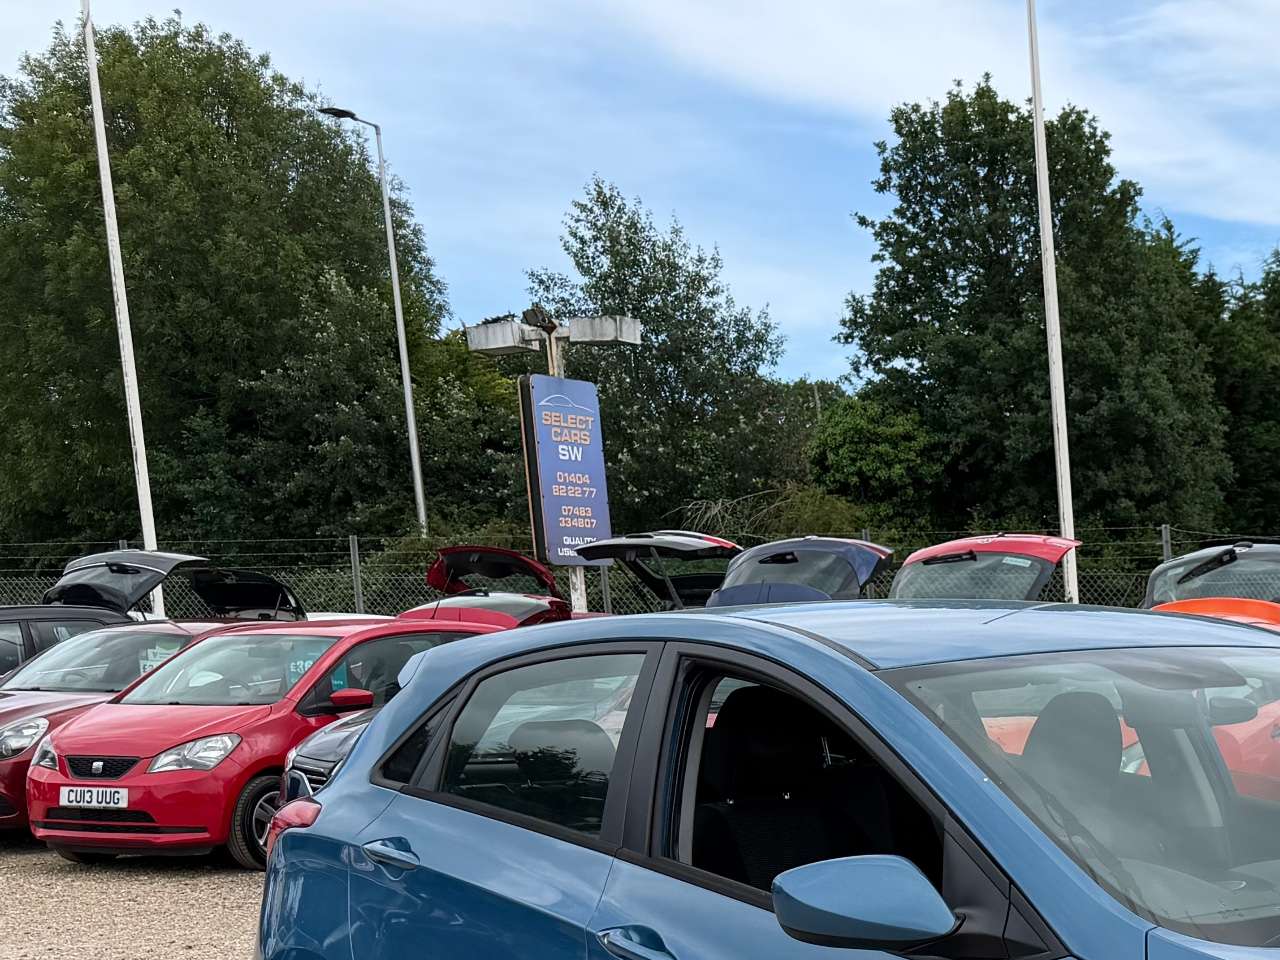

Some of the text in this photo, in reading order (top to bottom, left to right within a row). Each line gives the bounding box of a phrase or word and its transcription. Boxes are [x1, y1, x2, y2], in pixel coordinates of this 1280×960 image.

[542, 411, 594, 430] SELECT
[551, 427, 591, 445] CARS
[558, 445, 583, 461] SW
[556, 471, 591, 485] 01404
[67, 789, 121, 805] CU13 UUG
